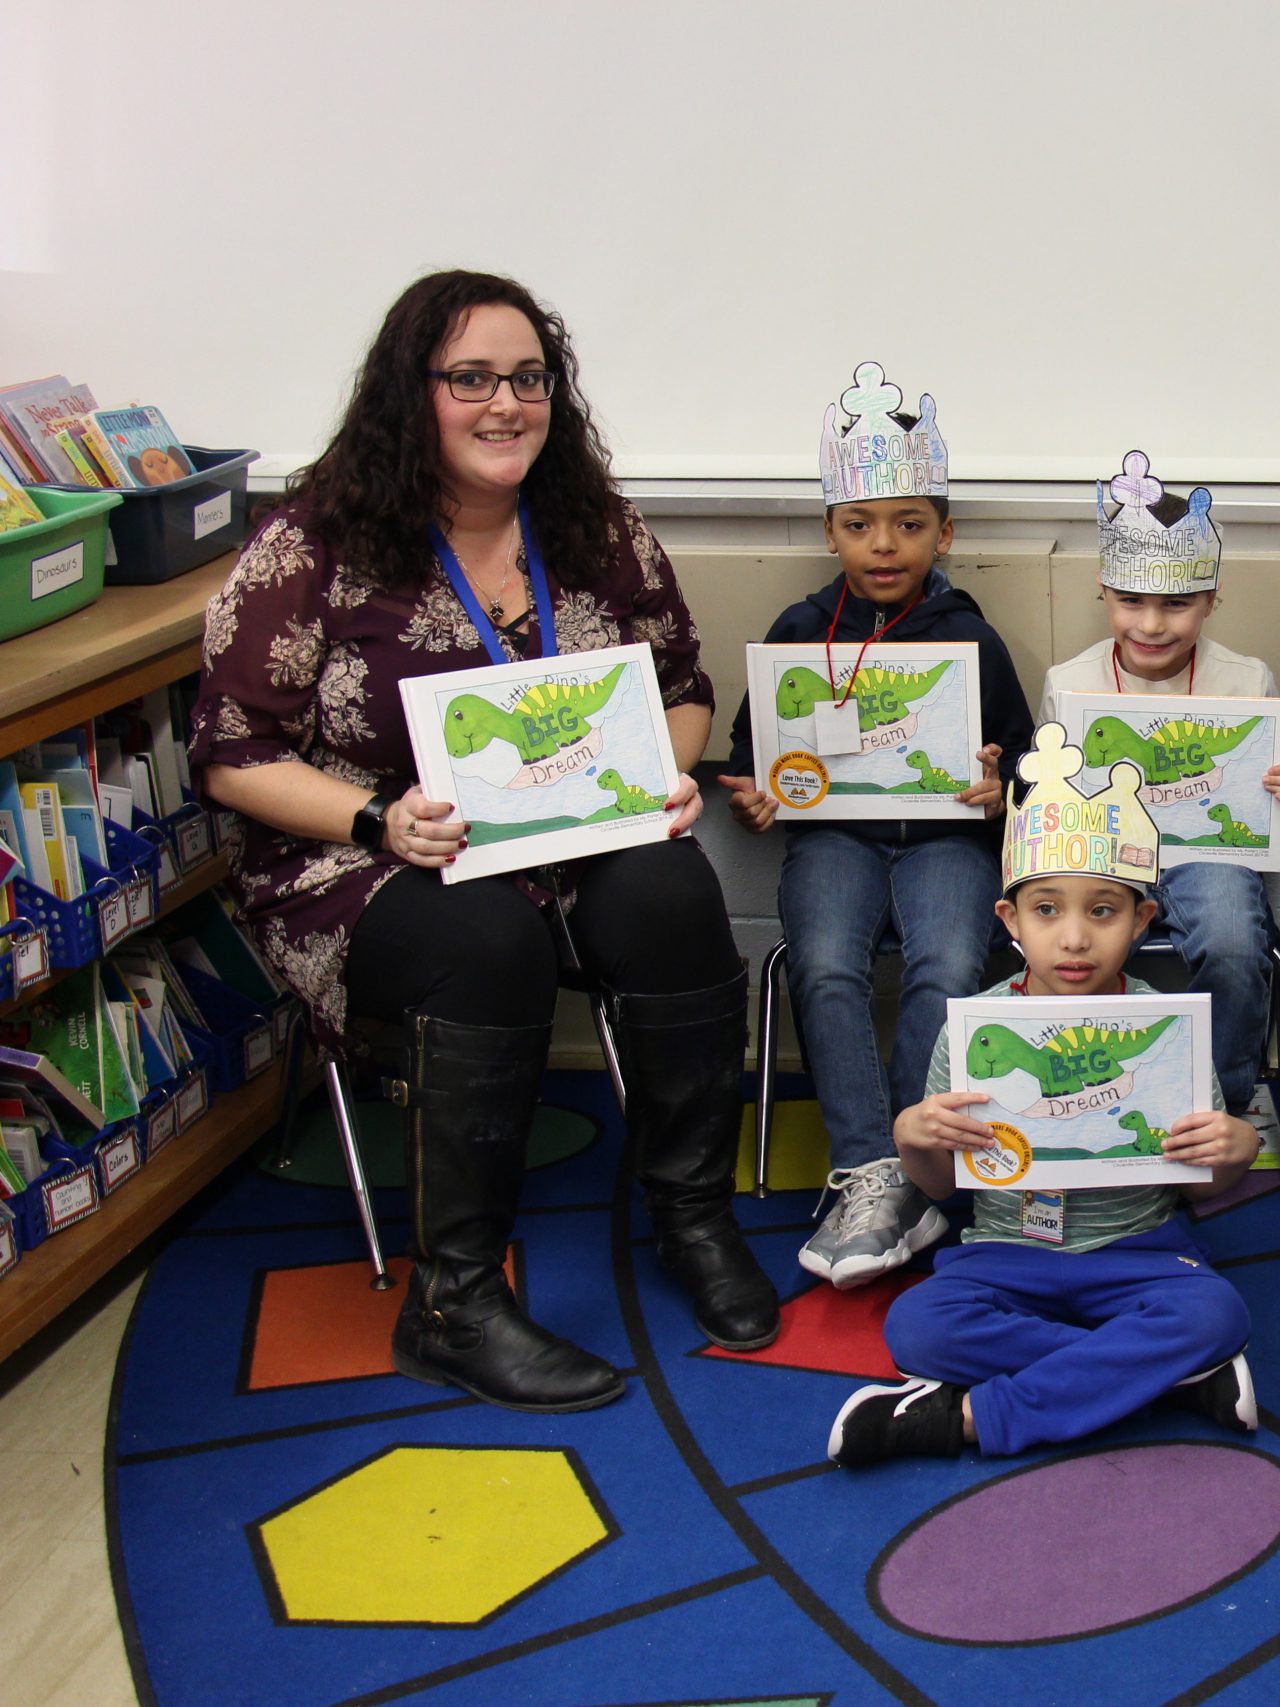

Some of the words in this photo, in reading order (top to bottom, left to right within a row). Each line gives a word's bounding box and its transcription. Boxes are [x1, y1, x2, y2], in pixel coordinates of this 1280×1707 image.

[59, 395, 91, 415] Talk
[828, 433, 930, 468] AWESOME
[833, 462, 931, 500] AUTHOR!
[197, 510, 224, 524] Manners
[37, 559, 77, 584] Dinosaurs
[1105, 554, 1193, 593] UTHOR!
[872, 660, 916, 674] Dino's
[500, 682, 532, 711] Little
[544, 673, 591, 687] Dino's
[521, 706, 579, 748] BIG
[861, 726, 906, 750] ream
[1138, 716, 1170, 738] Little
[1182, 713, 1227, 728] Dino's
[529, 745, 594, 784] Dream
[1153, 742, 1205, 772] BIG
[782, 774, 793, 782] Love
[1150, 779, 1211, 804] Dream
[1007, 802, 1120, 843] AWESOME
[1004, 833, 1117, 884] AUTHOR!
[68, 1018, 78, 1047] KEVIN
[77, 1012, 89, 1050] CORNELL
[1030, 1021, 1066, 1048] Little
[1081, 1017, 1133, 1031] Dino's
[1049, 1049, 1111, 1083] BIG
[1047, 1087, 1120, 1117] Dream
[108, 1153, 129, 1172] Colors
[1026, 1214, 1058, 1230] AUTHOR!
